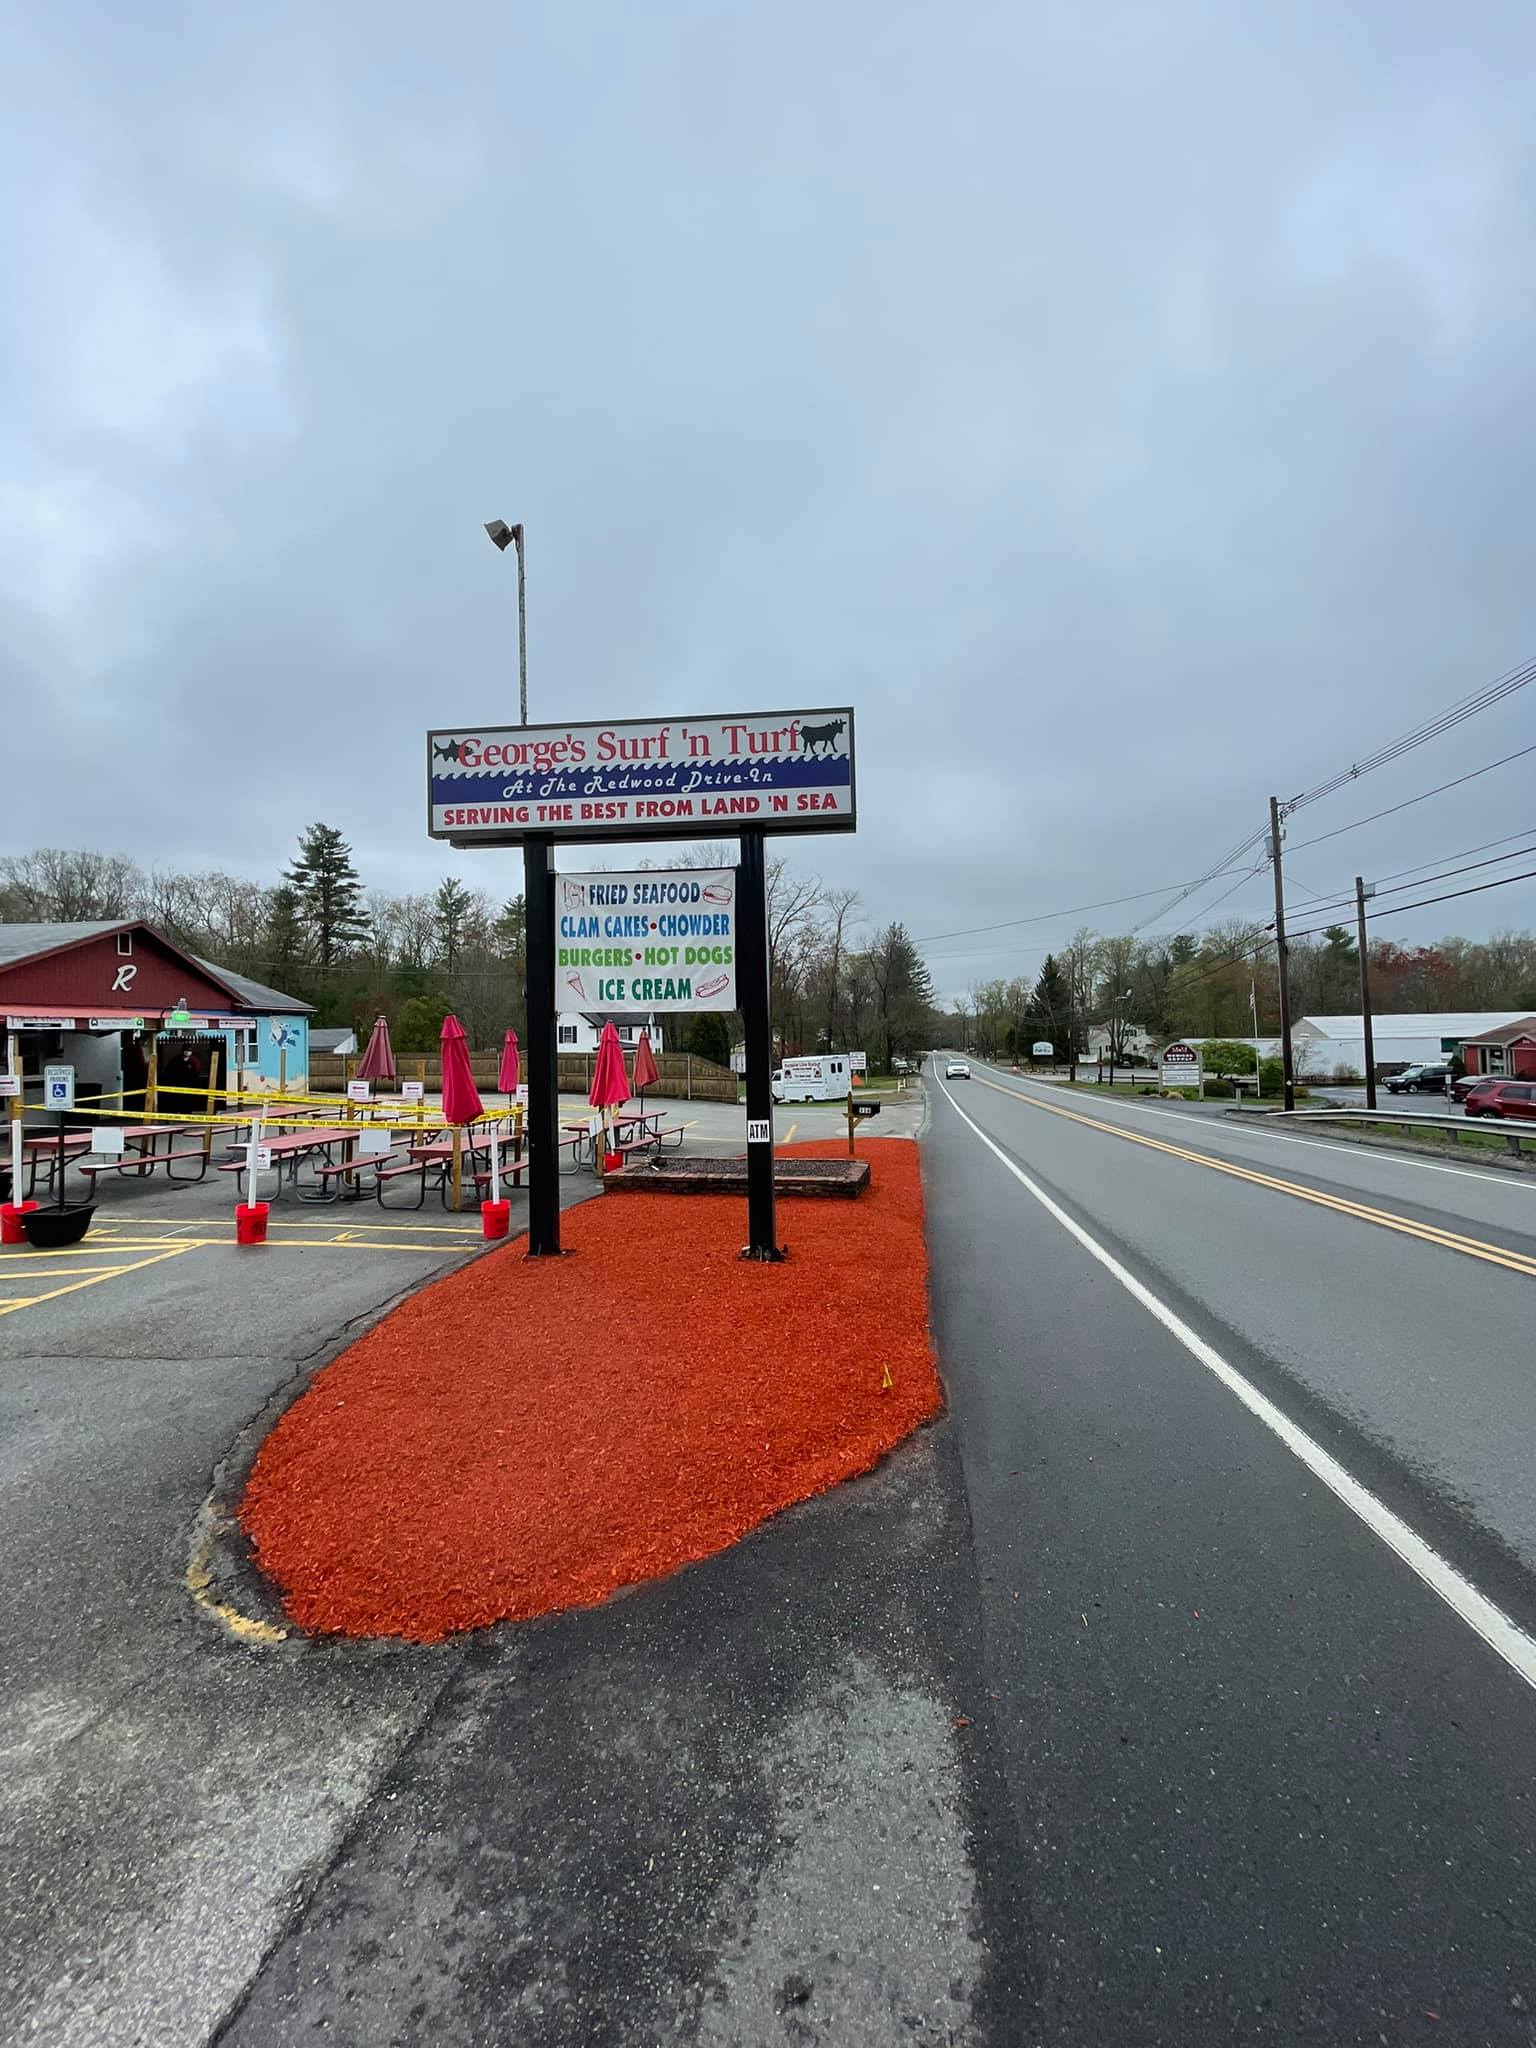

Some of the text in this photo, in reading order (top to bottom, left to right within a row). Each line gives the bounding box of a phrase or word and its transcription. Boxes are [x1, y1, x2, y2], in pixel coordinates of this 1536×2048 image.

[459, 719, 801, 773] George's Surf 'n Turf
[502, 767, 774, 798] At The Redwood Drive-In
[444, 793, 838, 826] SERVING THE BEST FROM LAND 'N SEA
[588, 882, 701, 905] FRIED SEAFOOD
[560, 915, 600, 938] CLAM
[558, 945, 733, 967] BURGERS HOT DOGS
[112, 964, 137, 991] R
[599, 978, 692, 1001] ICE CREAM
[750, 1124, 768, 1139] ATM
